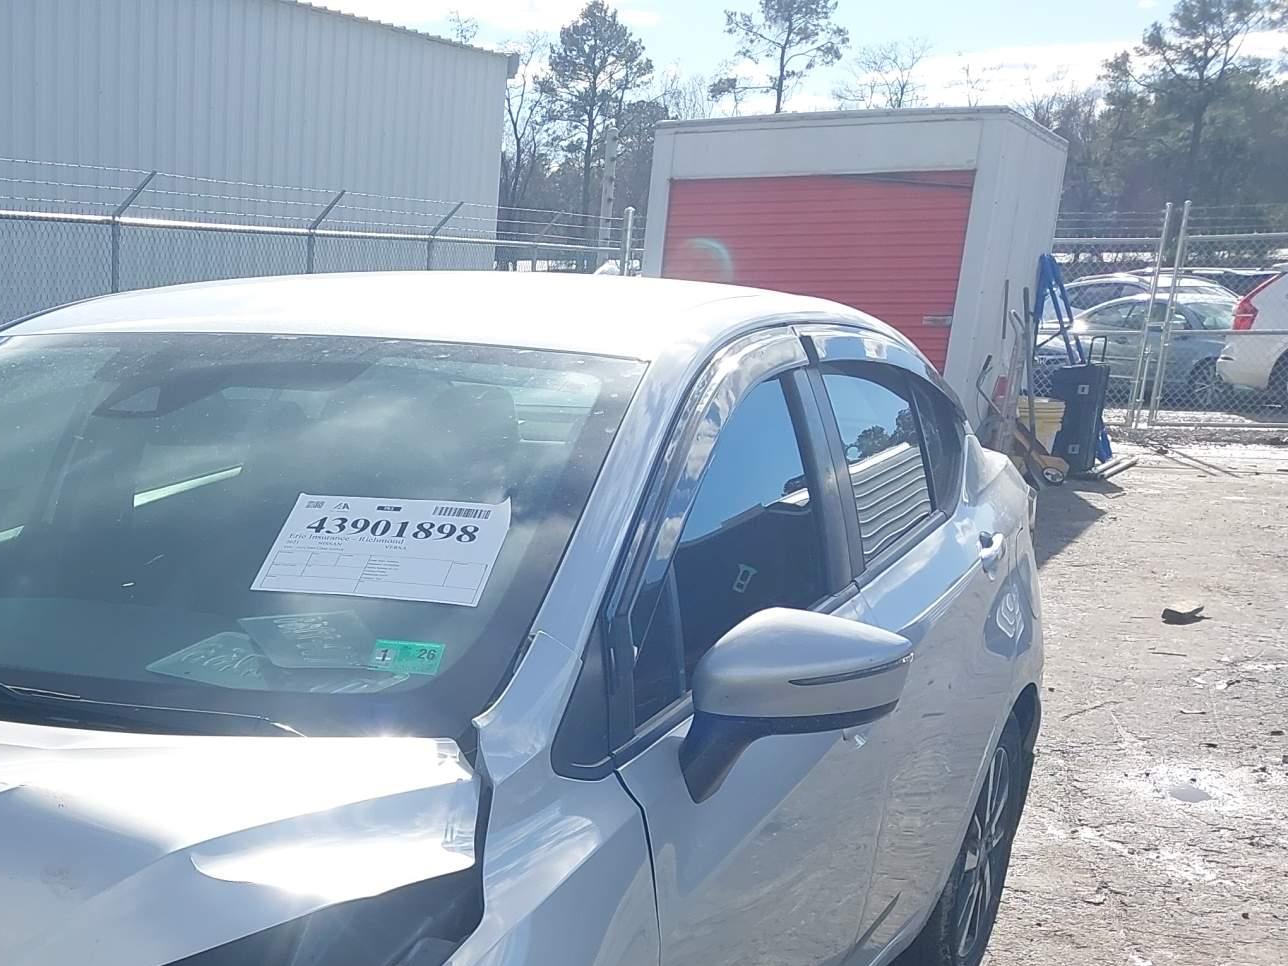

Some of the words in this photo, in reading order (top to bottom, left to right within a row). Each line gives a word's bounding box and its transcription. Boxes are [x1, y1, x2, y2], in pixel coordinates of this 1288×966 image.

[306, 516, 480, 543] 43901898
[309, 534, 349, 542] Insurance
[359, 536, 405, 545] Richmond
[417, 649, 437, 661] 26
